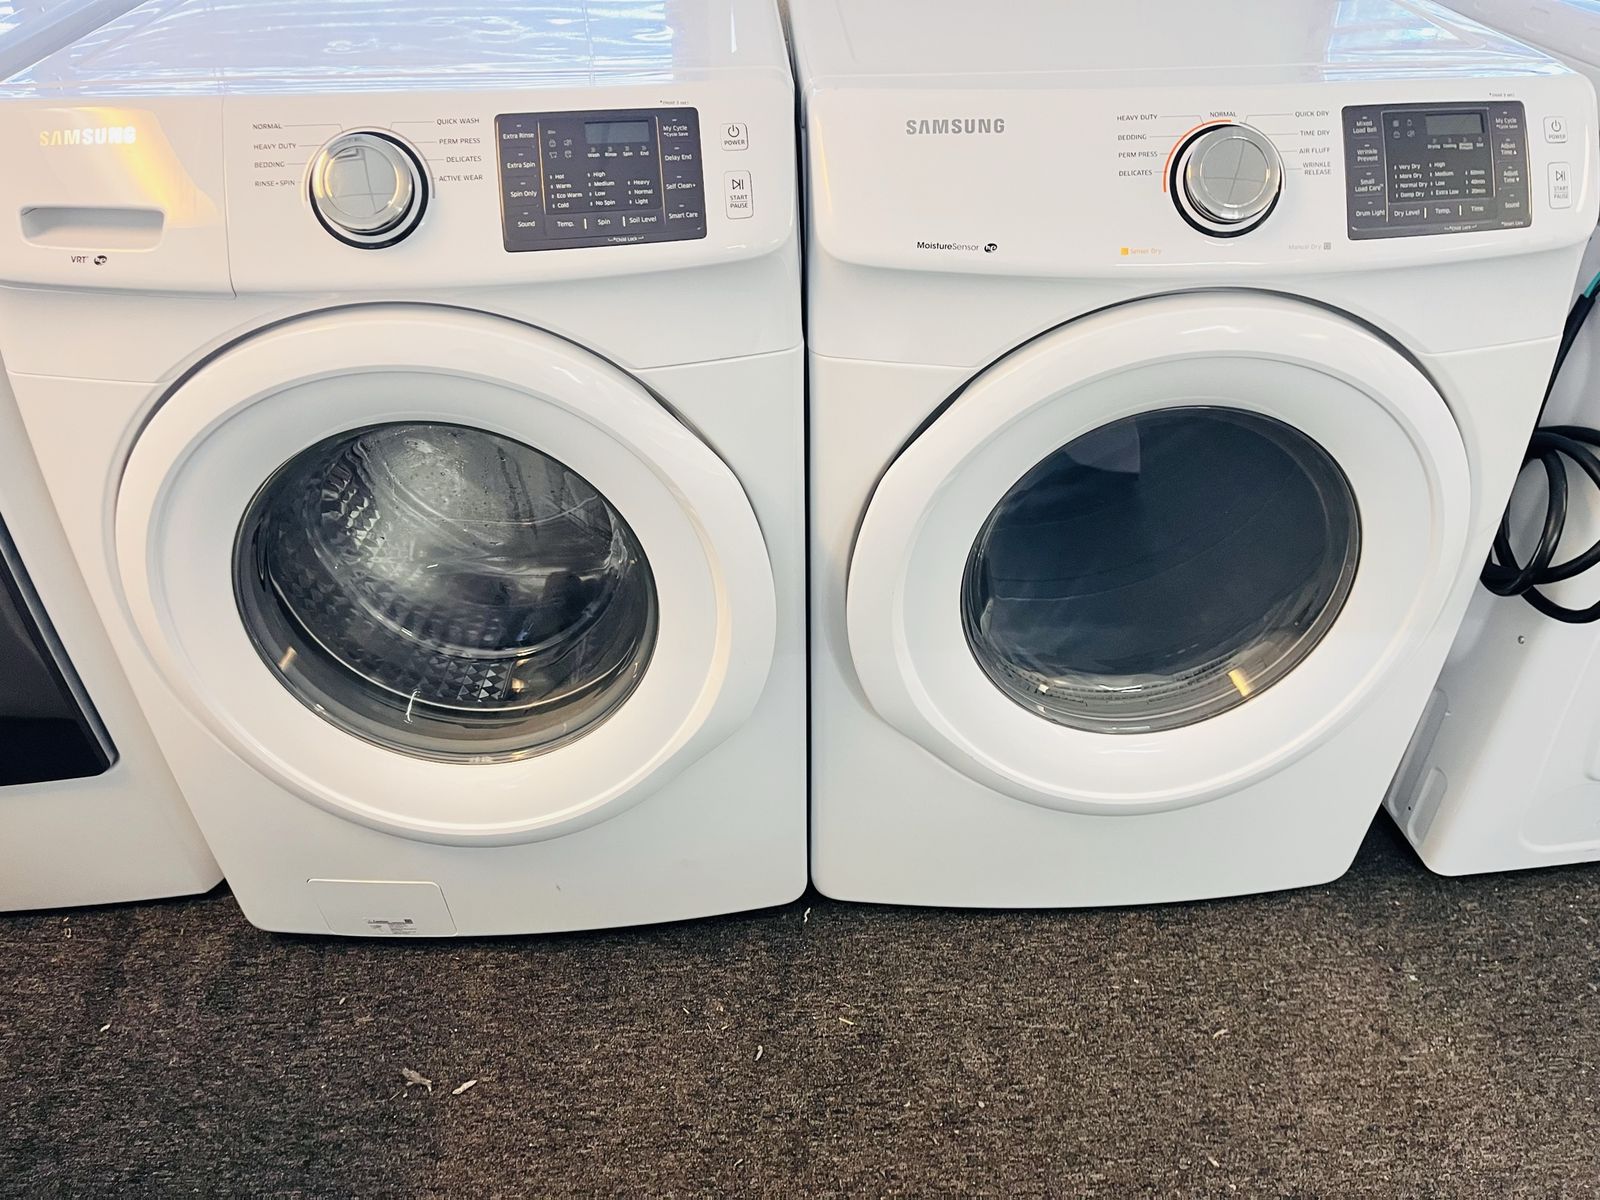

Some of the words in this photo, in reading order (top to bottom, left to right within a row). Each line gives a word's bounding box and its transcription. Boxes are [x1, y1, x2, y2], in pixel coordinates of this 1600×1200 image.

[906, 118, 1005, 135] SAMSUNG
[40, 126, 136, 146] SAMSUNG
[523, 161, 536, 169] Spin
[524, 190, 537, 198] Only
[1371, 209, 1385, 217] Light
[517, 220, 535, 228] Sound
[597, 218, 611, 226] Spin
